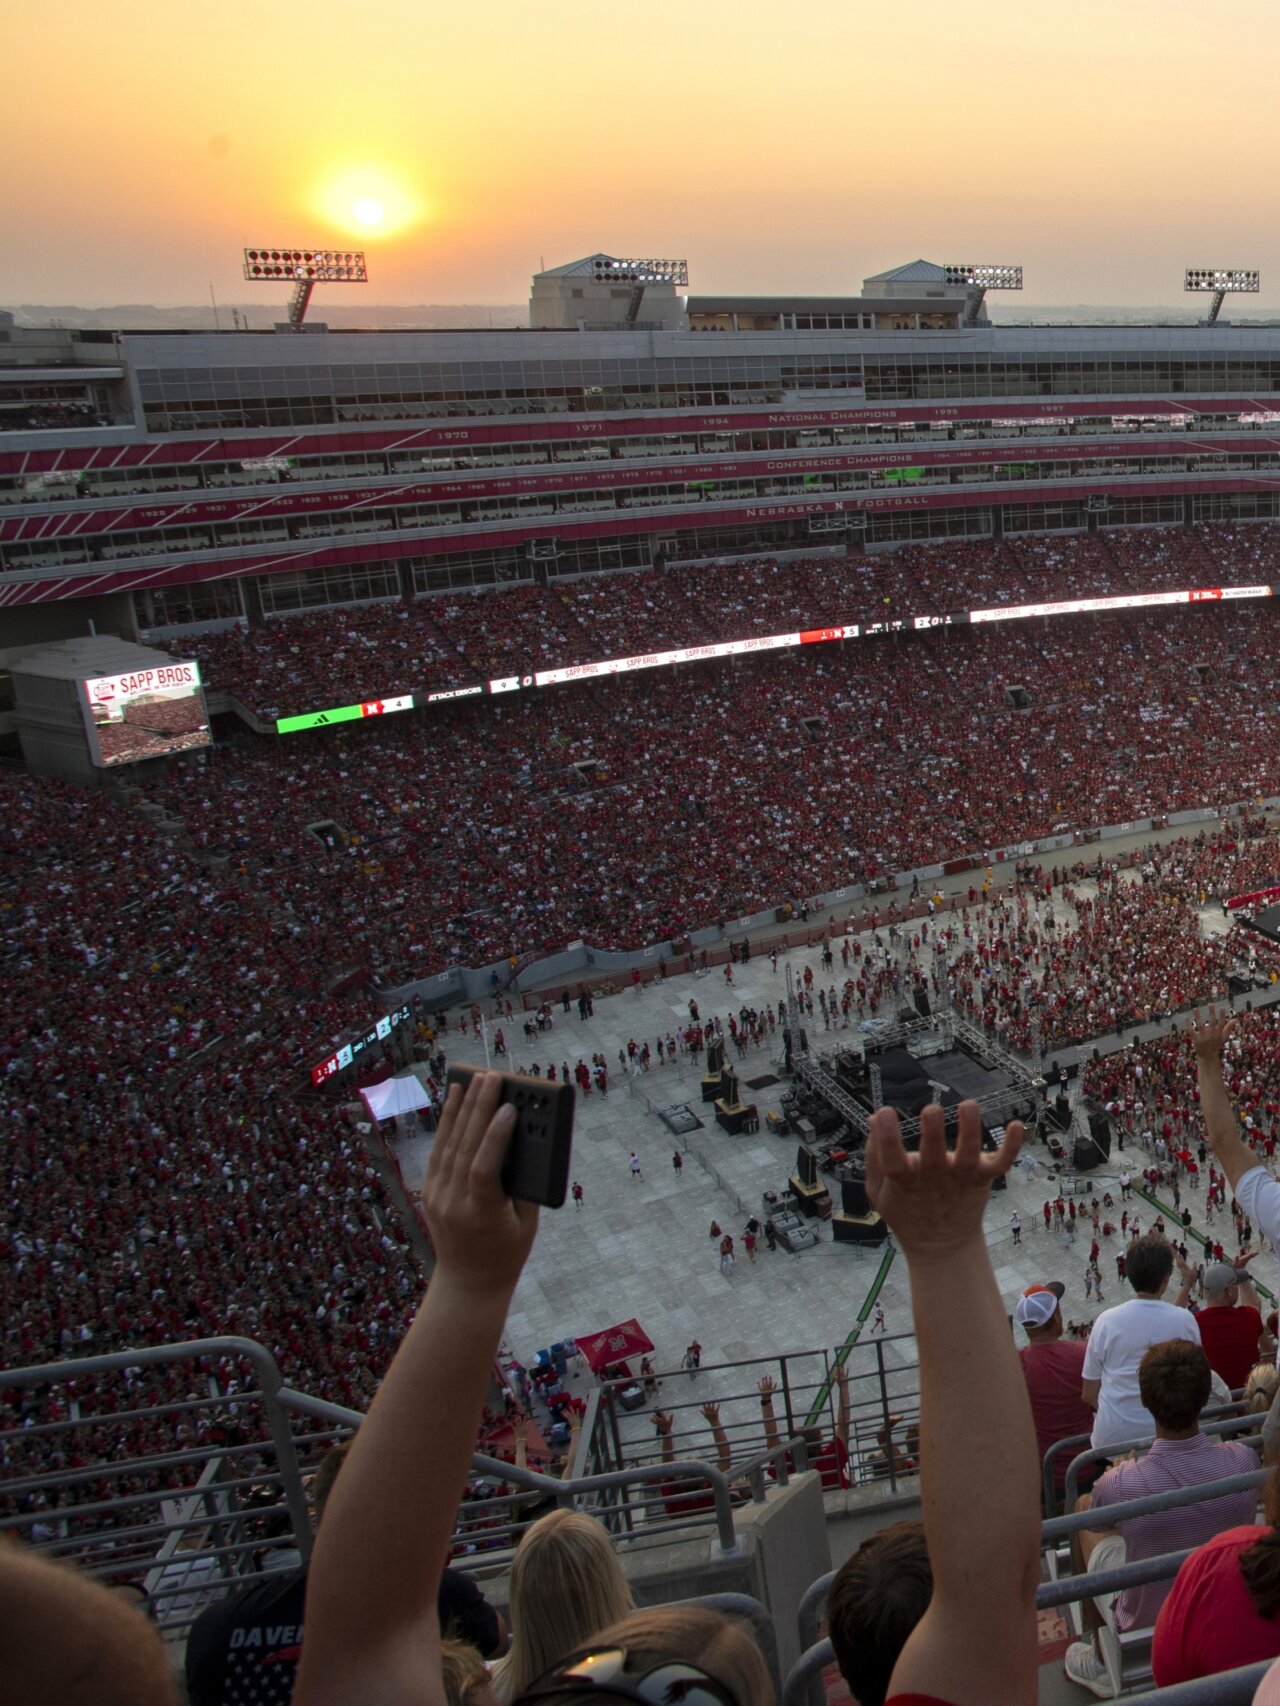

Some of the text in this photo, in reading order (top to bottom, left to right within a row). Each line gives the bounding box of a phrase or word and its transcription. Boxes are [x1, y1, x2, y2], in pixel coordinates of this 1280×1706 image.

[438, 430, 469, 440] 1970
[576, 423, 603, 432] 1971
[769, 414, 826, 423] NATIONAL
[831, 411, 897, 420] CHAMPIONS
[768, 458, 842, 470] CONFERENCE
[847, 454, 913, 465] CHAMPIONS
[747, 496, 928, 517] NEBRASKA N FOOTBALL
[685, 649, 701, 659] SAPP
[627, 659, 642, 669] SAPP
[566, 668, 582, 678] SAPP
[120, 671, 154, 693] SAPP
[428, 691, 455, 701] ATTACK
[366, 703, 379, 715] N
[343, 1051, 349, 1061] 5
[380, 1023, 387, 1034] 2
